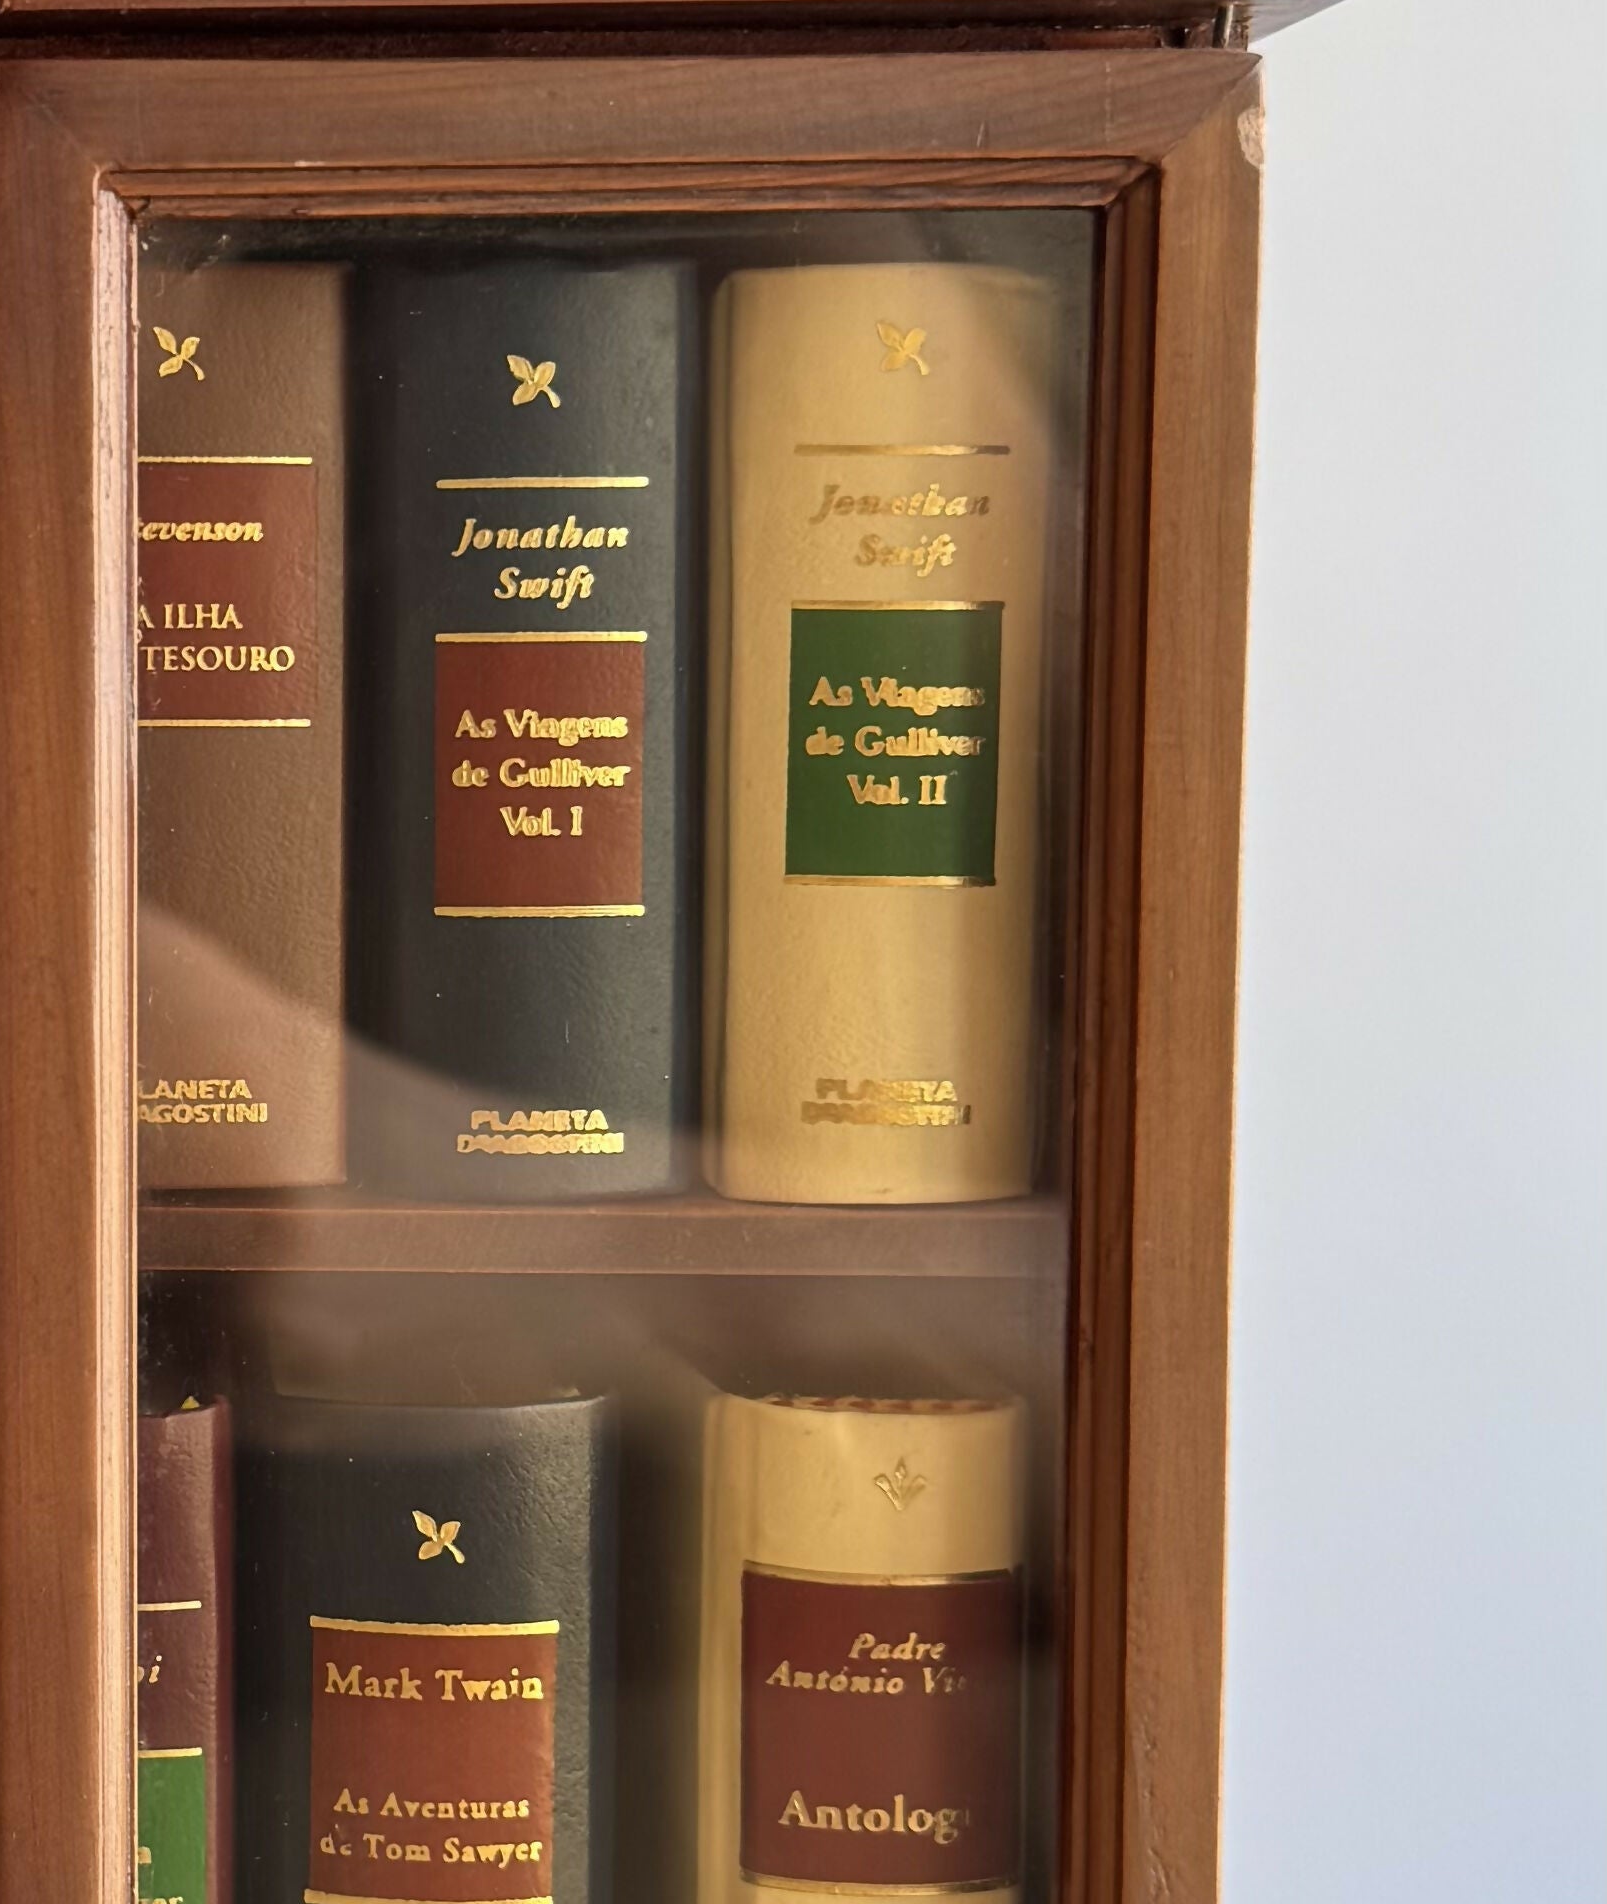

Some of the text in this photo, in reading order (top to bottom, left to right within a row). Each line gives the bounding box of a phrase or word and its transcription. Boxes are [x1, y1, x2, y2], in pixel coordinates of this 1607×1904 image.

[807, 482, 991, 526] Jonathan
[450, 514, 630, 558] Jonathan
[493, 564, 595, 611] Swift
[163, 602, 244, 631] ILHA
[140, 645, 296, 673] TESOURO
[808, 675, 987, 717] As Viagens
[454, 707, 629, 748] As Viagens
[804, 724, 987, 758] de Gulliver
[451, 757, 632, 789] de Gulliver
[845, 773, 949, 806] Vol. II
[569, 805, 584, 837] I
[137, 1078, 253, 1100] LANETA
[137, 1102, 268, 1124] AGOSTINI
[470, 1108, 610, 1133] PLANETA
[847, 1631, 947, 1662] Padre
[323, 1661, 545, 1702] Mark Twain
[764, 1659, 905, 1696] António
[332, 1787, 531, 1821] As Aventuras
[319, 1831, 544, 1870] de Tom Sawyer
